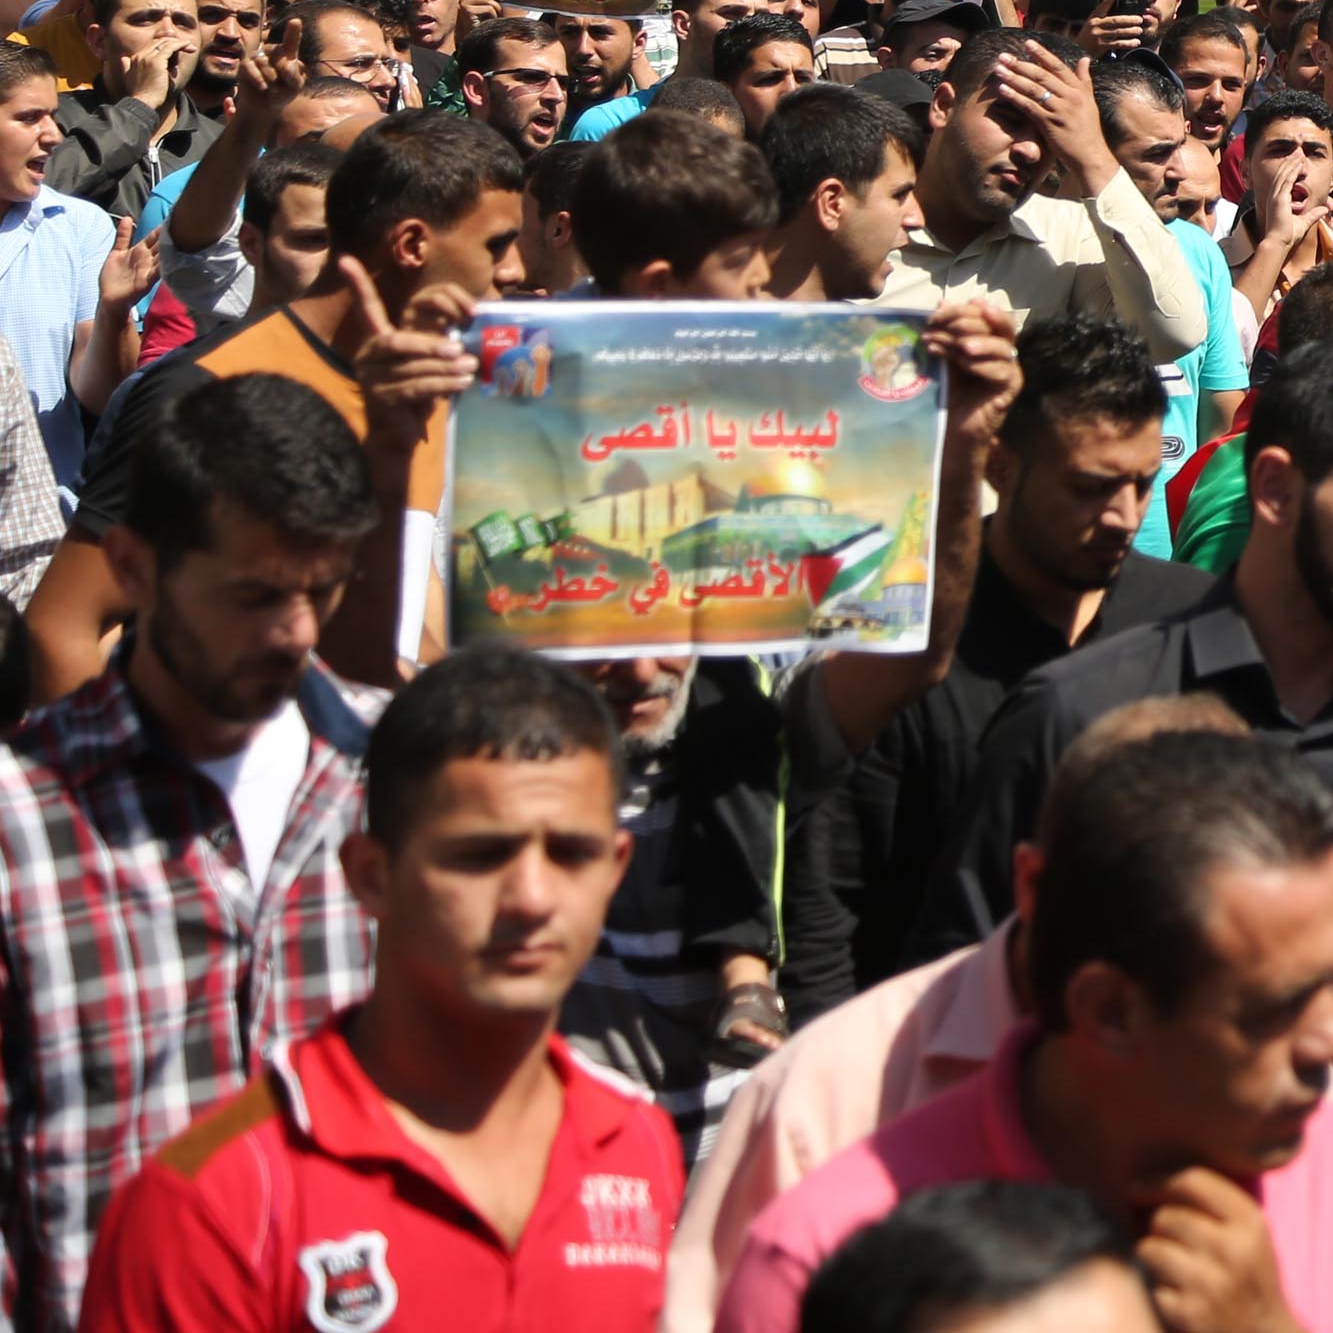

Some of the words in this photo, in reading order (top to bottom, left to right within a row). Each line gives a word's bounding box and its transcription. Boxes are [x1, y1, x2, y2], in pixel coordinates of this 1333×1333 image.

[580, 400, 691, 462] أقصى
[706, 408, 737, 460] يا
[749, 408, 840, 460] لبيك
[528, 563, 619, 611] خطر
[628, 561, 670, 615] في
[679, 552, 806, 608] الأقصى
